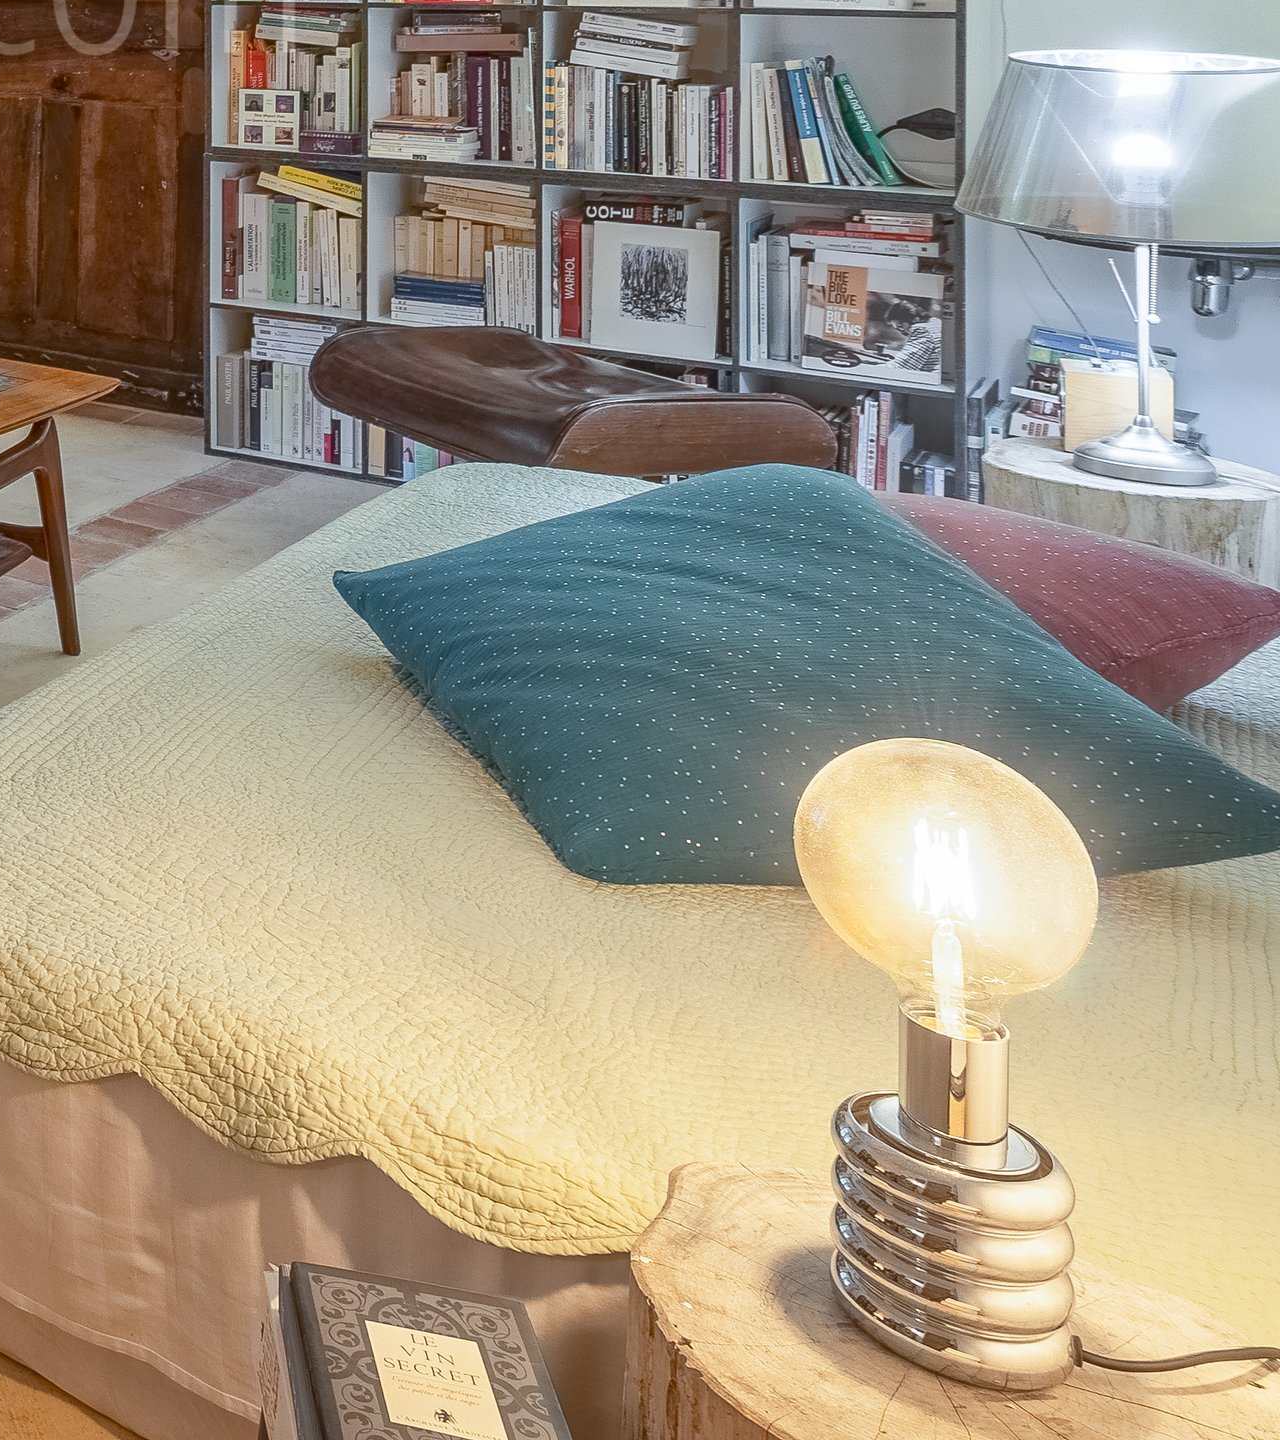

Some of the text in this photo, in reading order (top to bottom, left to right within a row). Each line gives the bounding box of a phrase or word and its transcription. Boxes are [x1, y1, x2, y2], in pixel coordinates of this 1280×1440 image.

[843, 83, 873, 133] ALPES DU SUD
[564, 256, 575, 299] WARHOL
[827, 269, 849, 283] THE
[829, 281, 848, 294] BIG
[827, 292, 857, 306] LOVE
[826, 310, 849, 324] BILL
[825, 321, 861, 337] EVANS
[224, 362, 233, 405] PAUL AUSTER
[410, 1333, 438, 1348] LE
[399, 1345, 456, 1366] VIN
[383, 1357, 480, 1387] SECRET
[391, 1375, 482, 1401] L'ivresse des mystiques
[398, 1384, 411, 1394] des
[437, 1391, 445, 1400] et
[445, 1392, 459, 1402] des
[459, 1397, 480, 1407] sages
